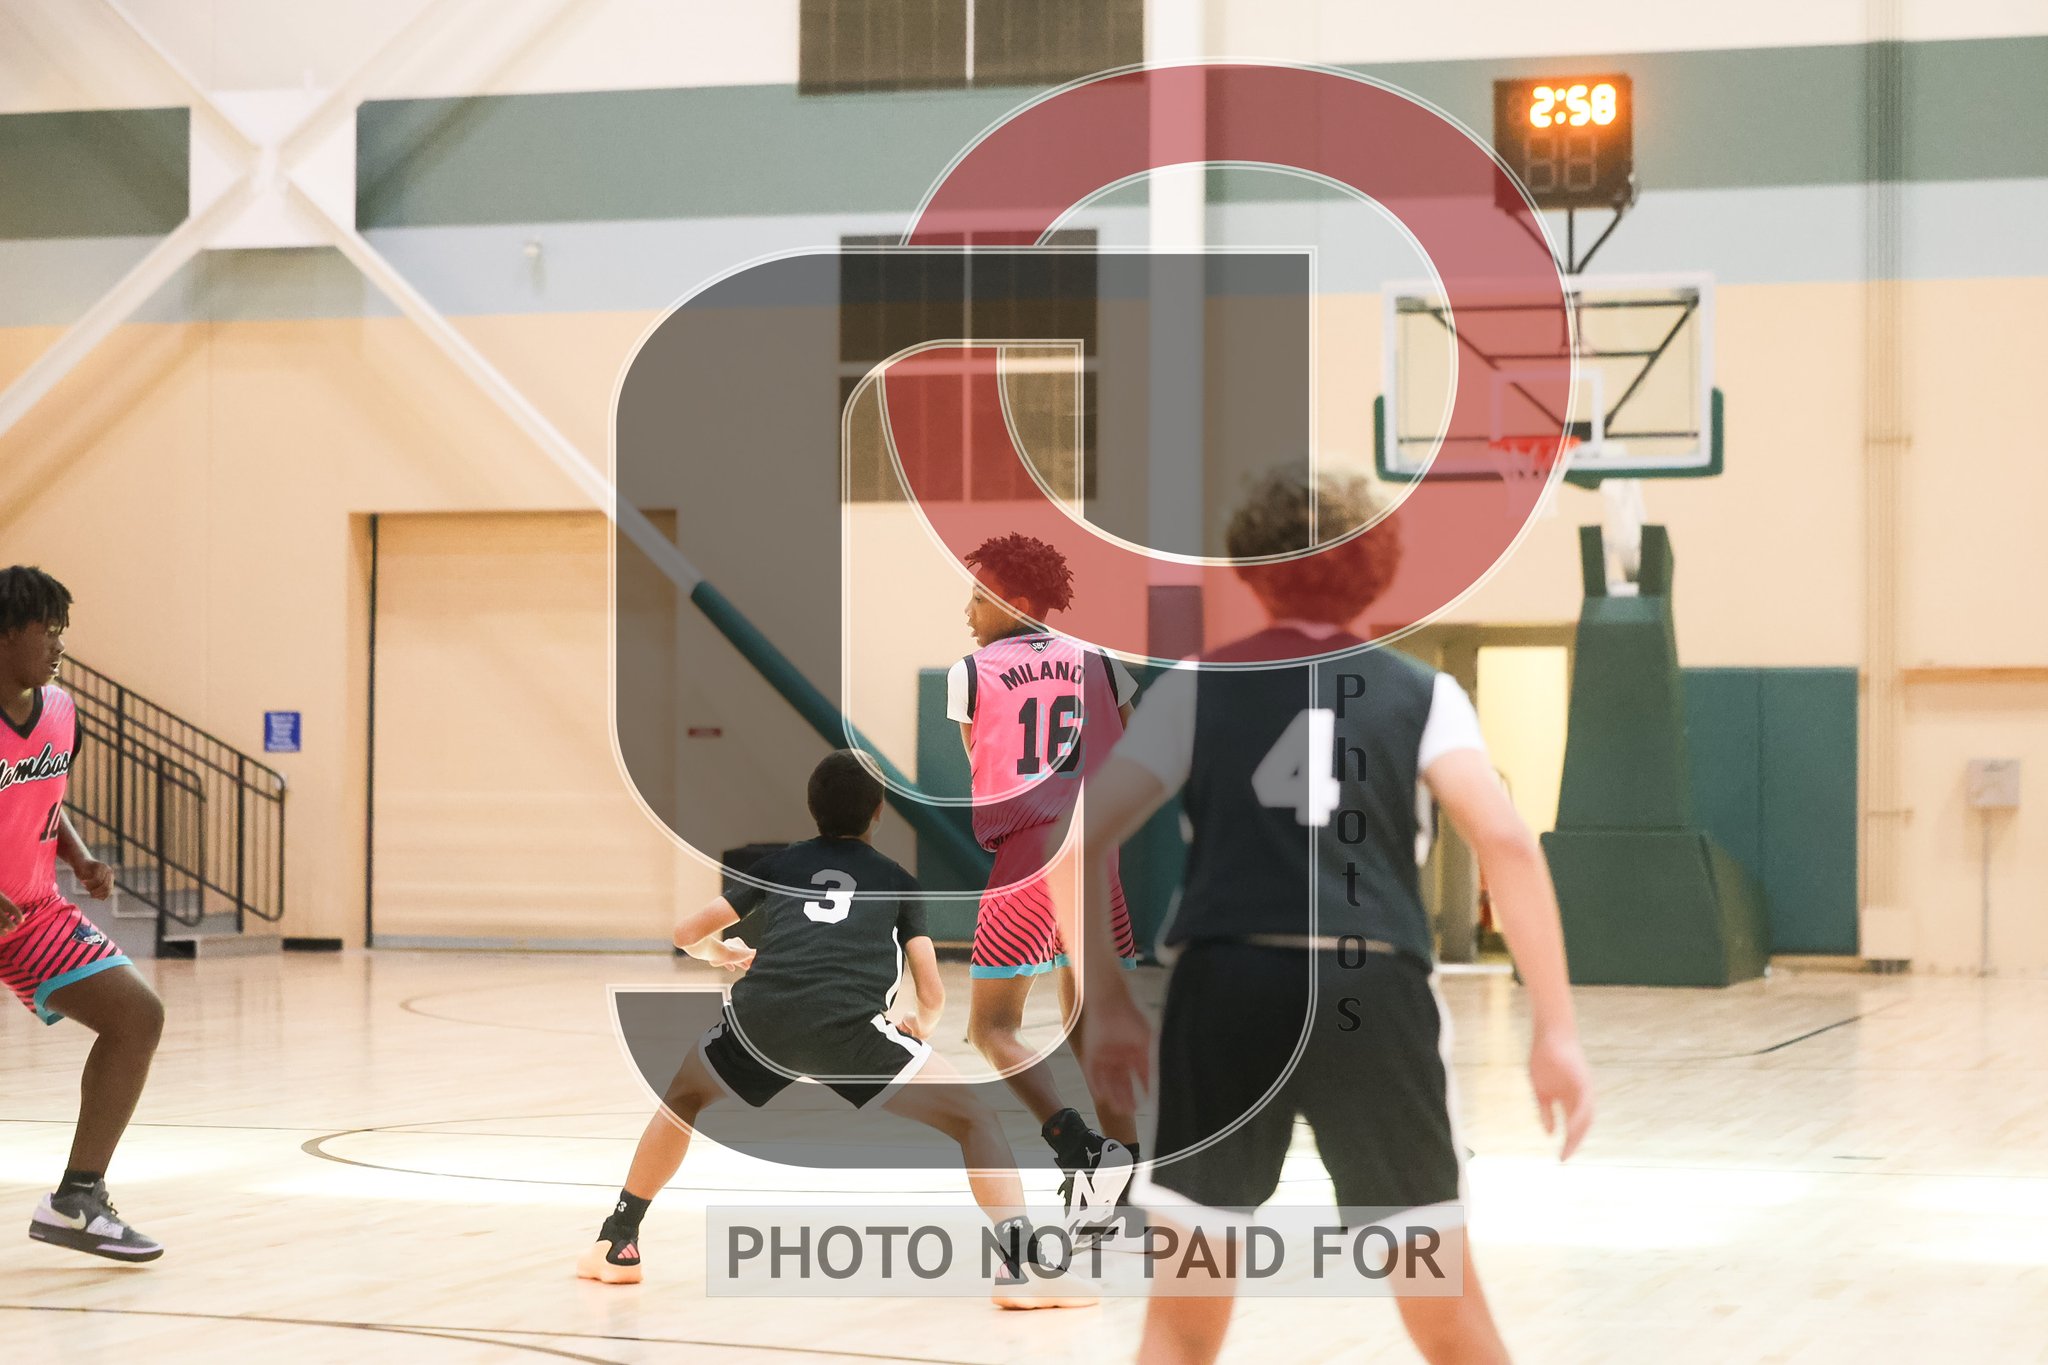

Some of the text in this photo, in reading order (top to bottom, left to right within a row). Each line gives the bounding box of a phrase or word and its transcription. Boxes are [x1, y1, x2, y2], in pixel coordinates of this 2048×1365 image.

[1529, 83, 1617, 129] 2:58
[999, 660, 1086, 692] MILANO
[1016, 694, 1087, 778] 16
[1251, 708, 1341, 828] 4
[803, 868, 858, 925] 3
